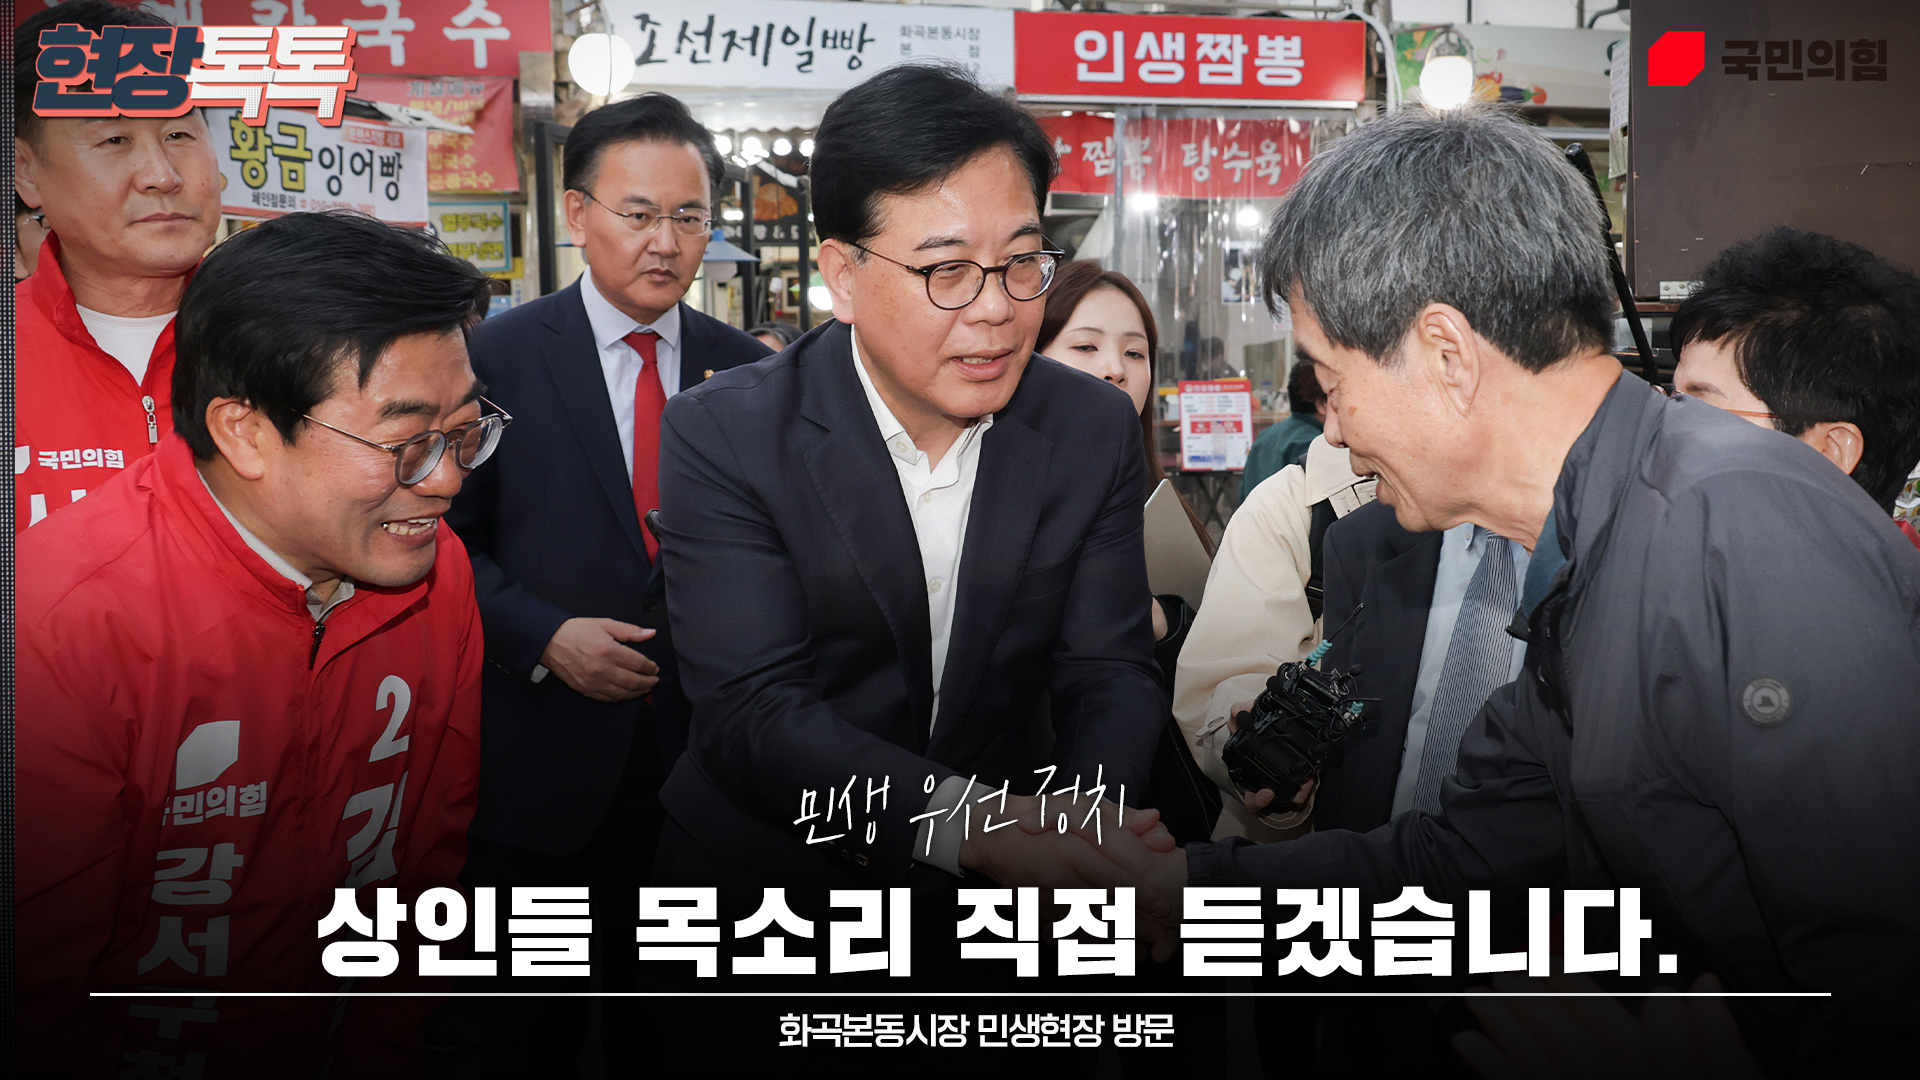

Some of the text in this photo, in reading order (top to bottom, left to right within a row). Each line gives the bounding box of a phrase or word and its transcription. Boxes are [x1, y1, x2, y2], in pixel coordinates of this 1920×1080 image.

[633, 13, 876, 74] 조선제일빵
[900, 24, 980, 41] 화곡본동시장
[1073, 29, 1305, 88] 인생짬뽕
[1181, 134, 1283, 186] 탕수육
[37, 448, 125, 470] 국민의힘
[369, 674, 412, 763] 2
